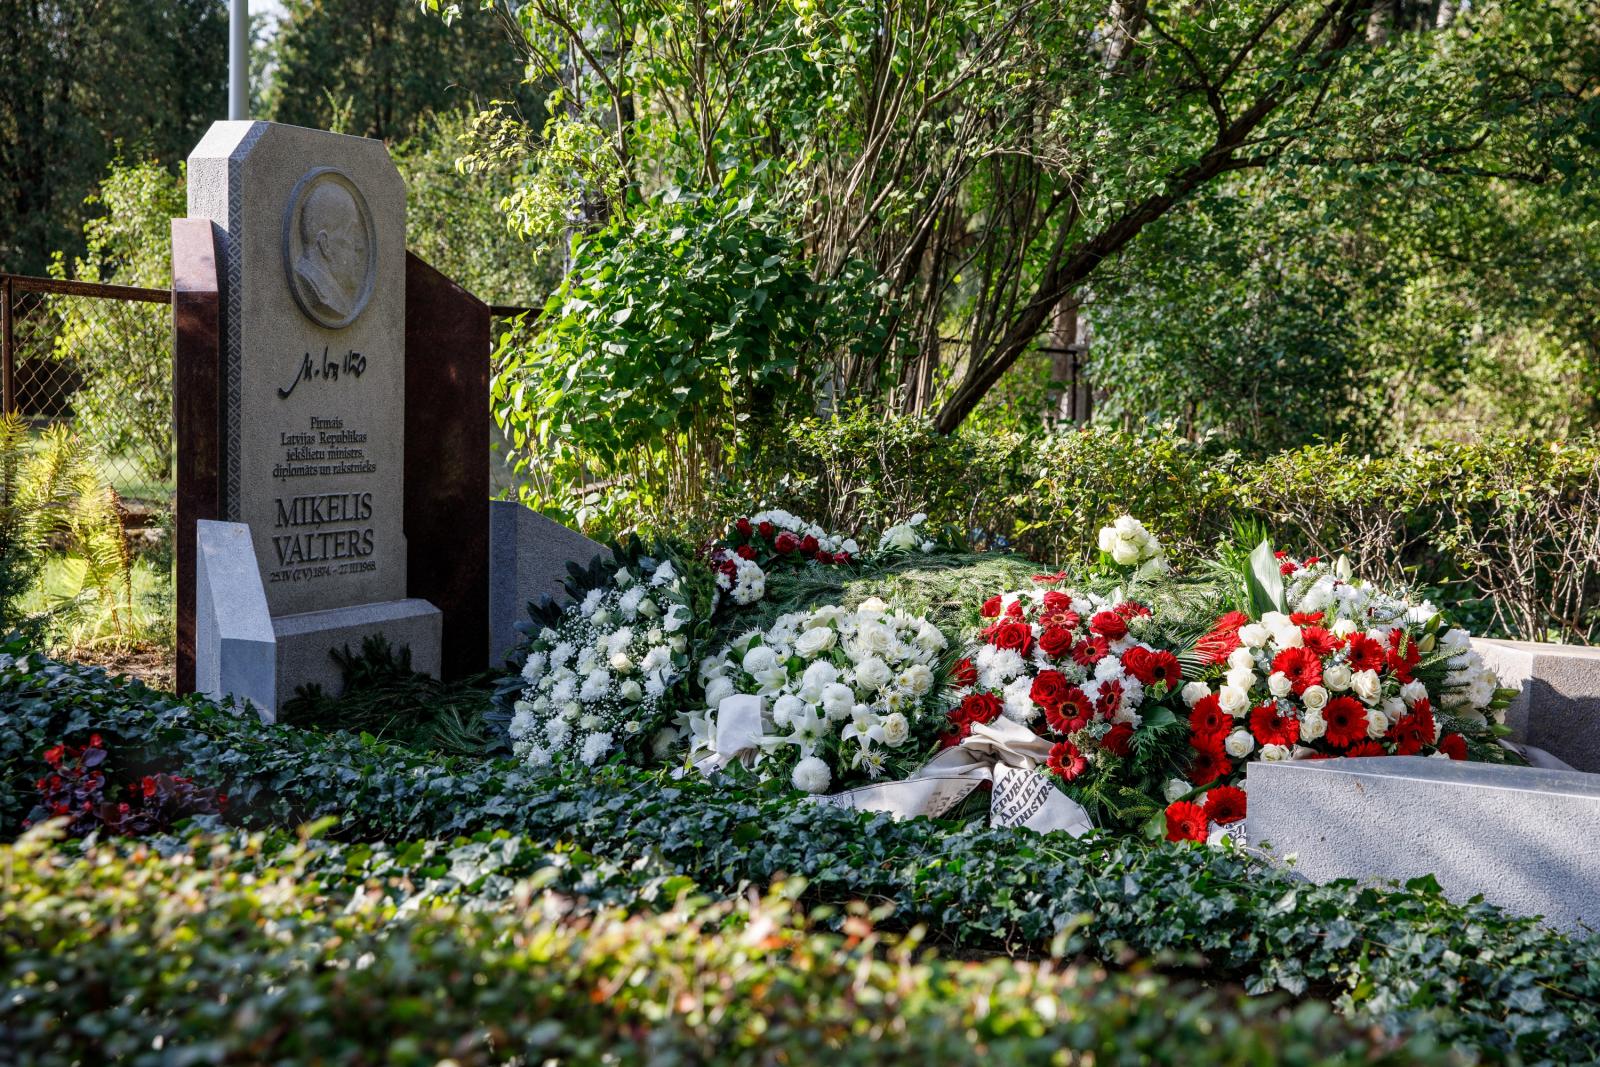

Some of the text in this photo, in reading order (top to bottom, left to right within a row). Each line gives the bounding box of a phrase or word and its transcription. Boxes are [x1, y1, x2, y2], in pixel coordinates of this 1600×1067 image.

[310, 416, 344, 430] Pirmais
[280, 430, 368, 447] Latvijas Republikas
[286, 447, 365, 461] iekšlietu ministrs,
[319, 465, 332, 475] un
[332, 460, 377, 475] rakstnieks
[274, 492, 373, 528] MIĶELIS
[271, 528, 374, 566] VALTERS
[992, 769, 1016, 805] ATVI
[1011, 780, 1056, 827] INISTRS
